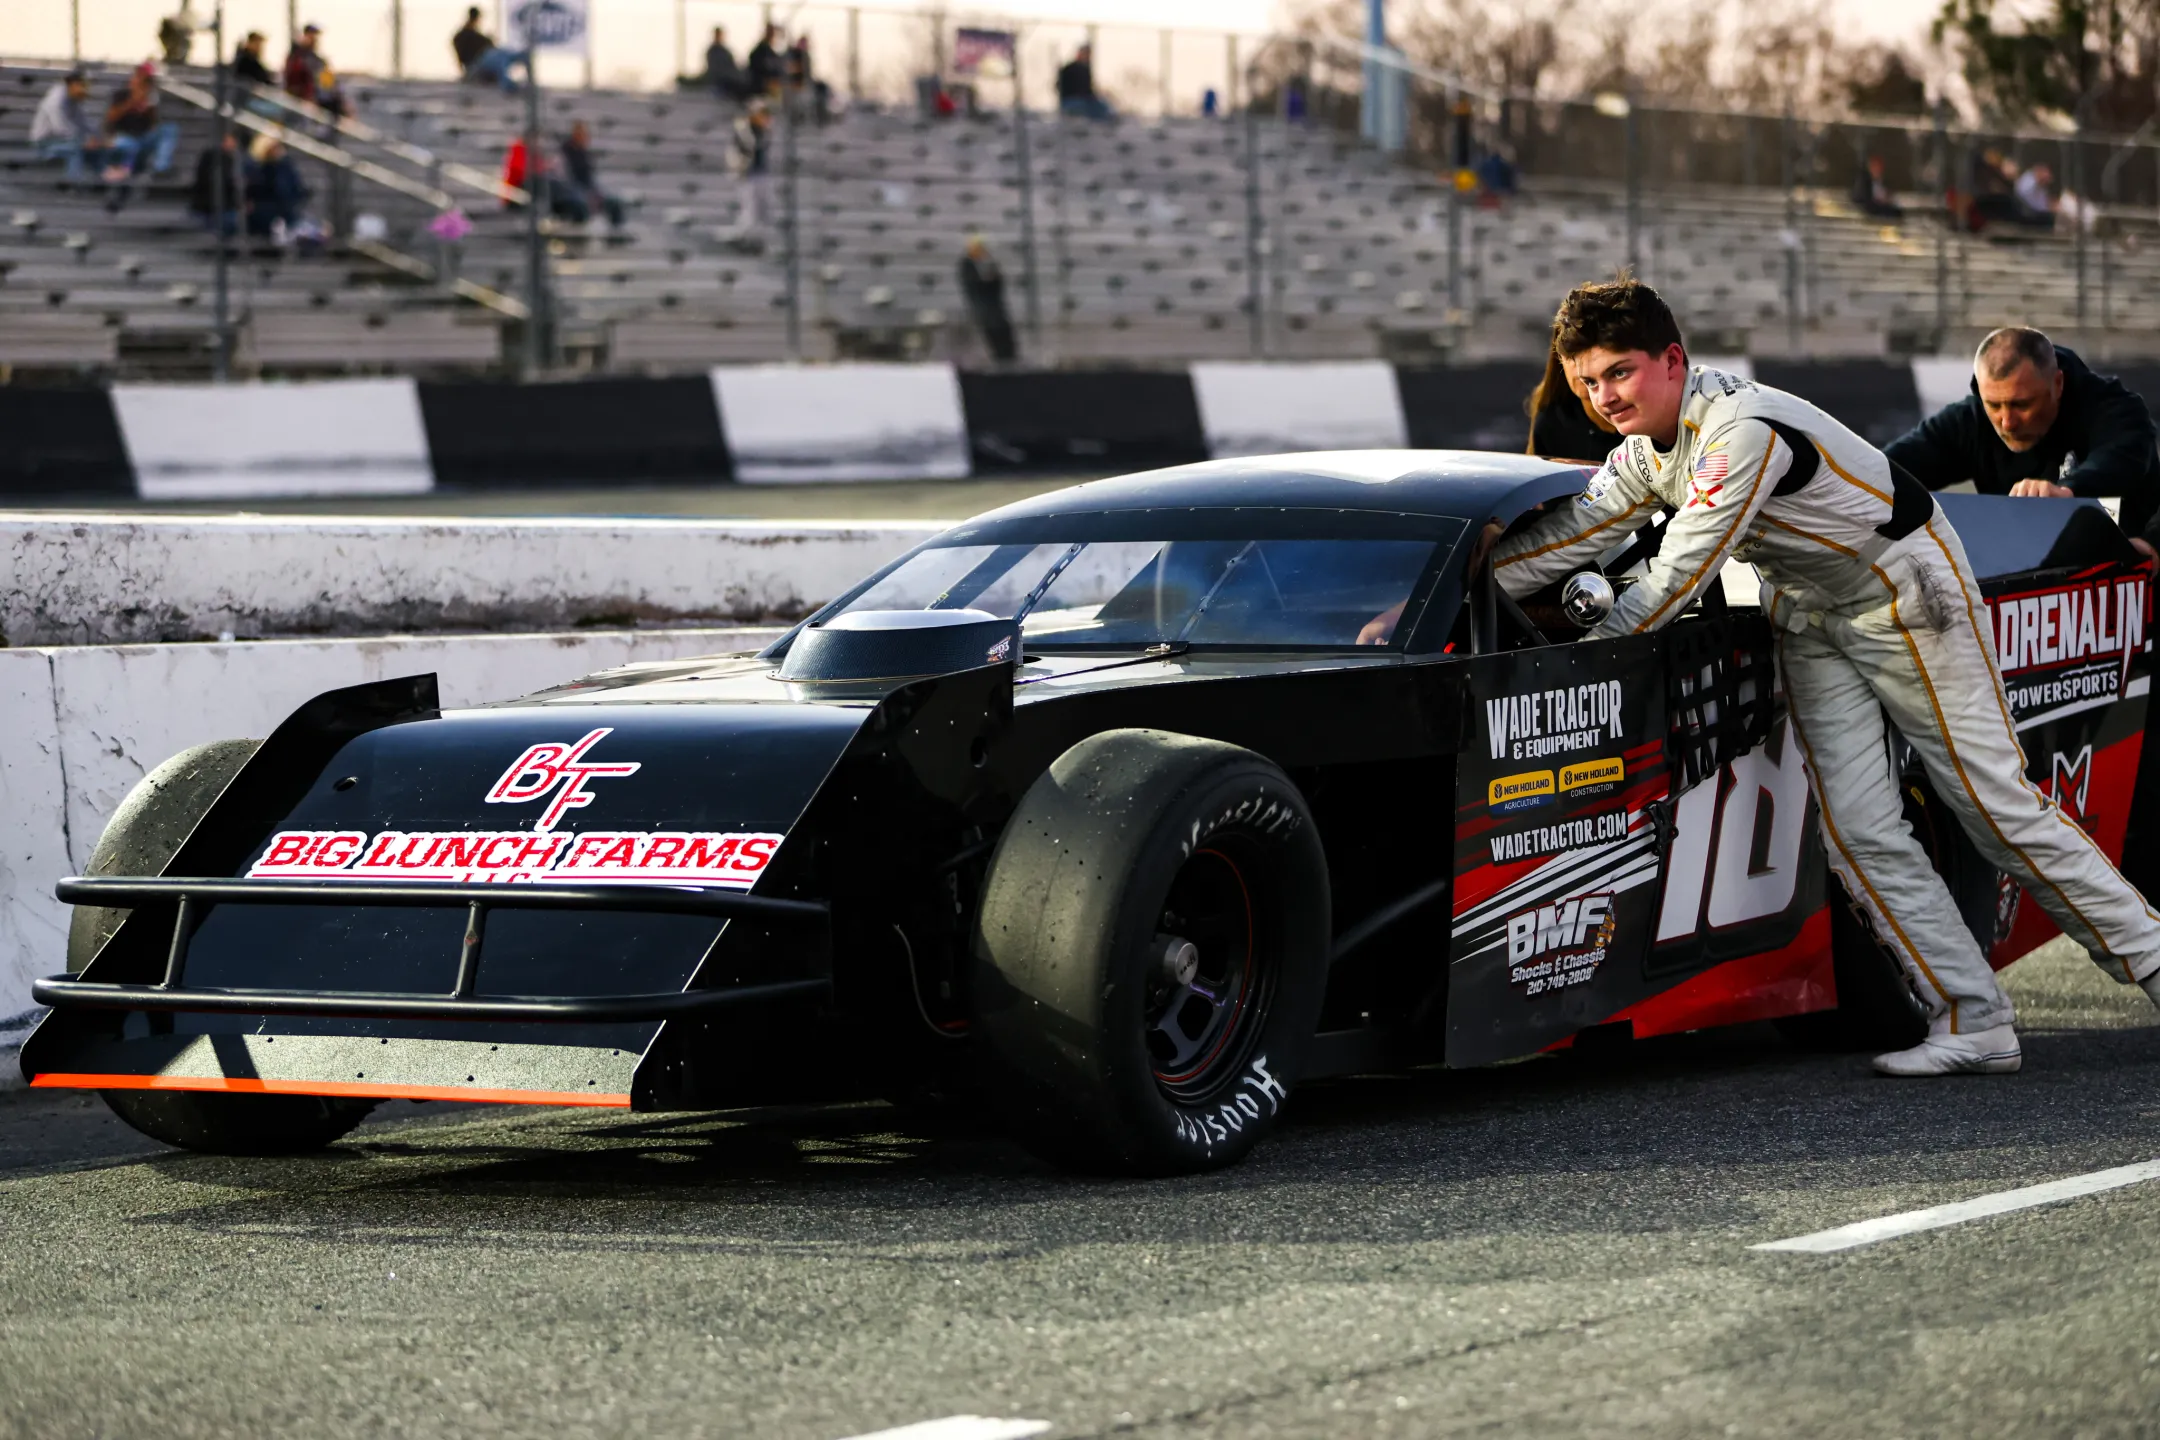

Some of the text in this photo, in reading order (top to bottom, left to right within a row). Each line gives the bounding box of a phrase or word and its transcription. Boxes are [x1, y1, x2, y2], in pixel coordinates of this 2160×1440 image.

[1633, 437, 1654, 484] sparco
[2009, 671, 2119, 710] POWERSPORTS
[1486, 680, 1623, 760] WADE TRACTOR
[1513, 729, 1601, 760] & EQUIPMENT
[1504, 778, 1550, 795] NEW HOLLAND
[1570, 782, 1614, 798] CONSTRUCTION
[1574, 765, 1619, 782] NEW HOLLAND
[1504, 796, 1540, 810] AGRICULTURE
[258, 835, 778, 872] BIG LUNCH FARMS
[1490, 811, 1627, 862] WADETRACTOR.COM
[1508, 896, 1610, 967] BMF
[1511, 961, 1553, 983] Shocks
[1563, 948, 1606, 970] Chassis
